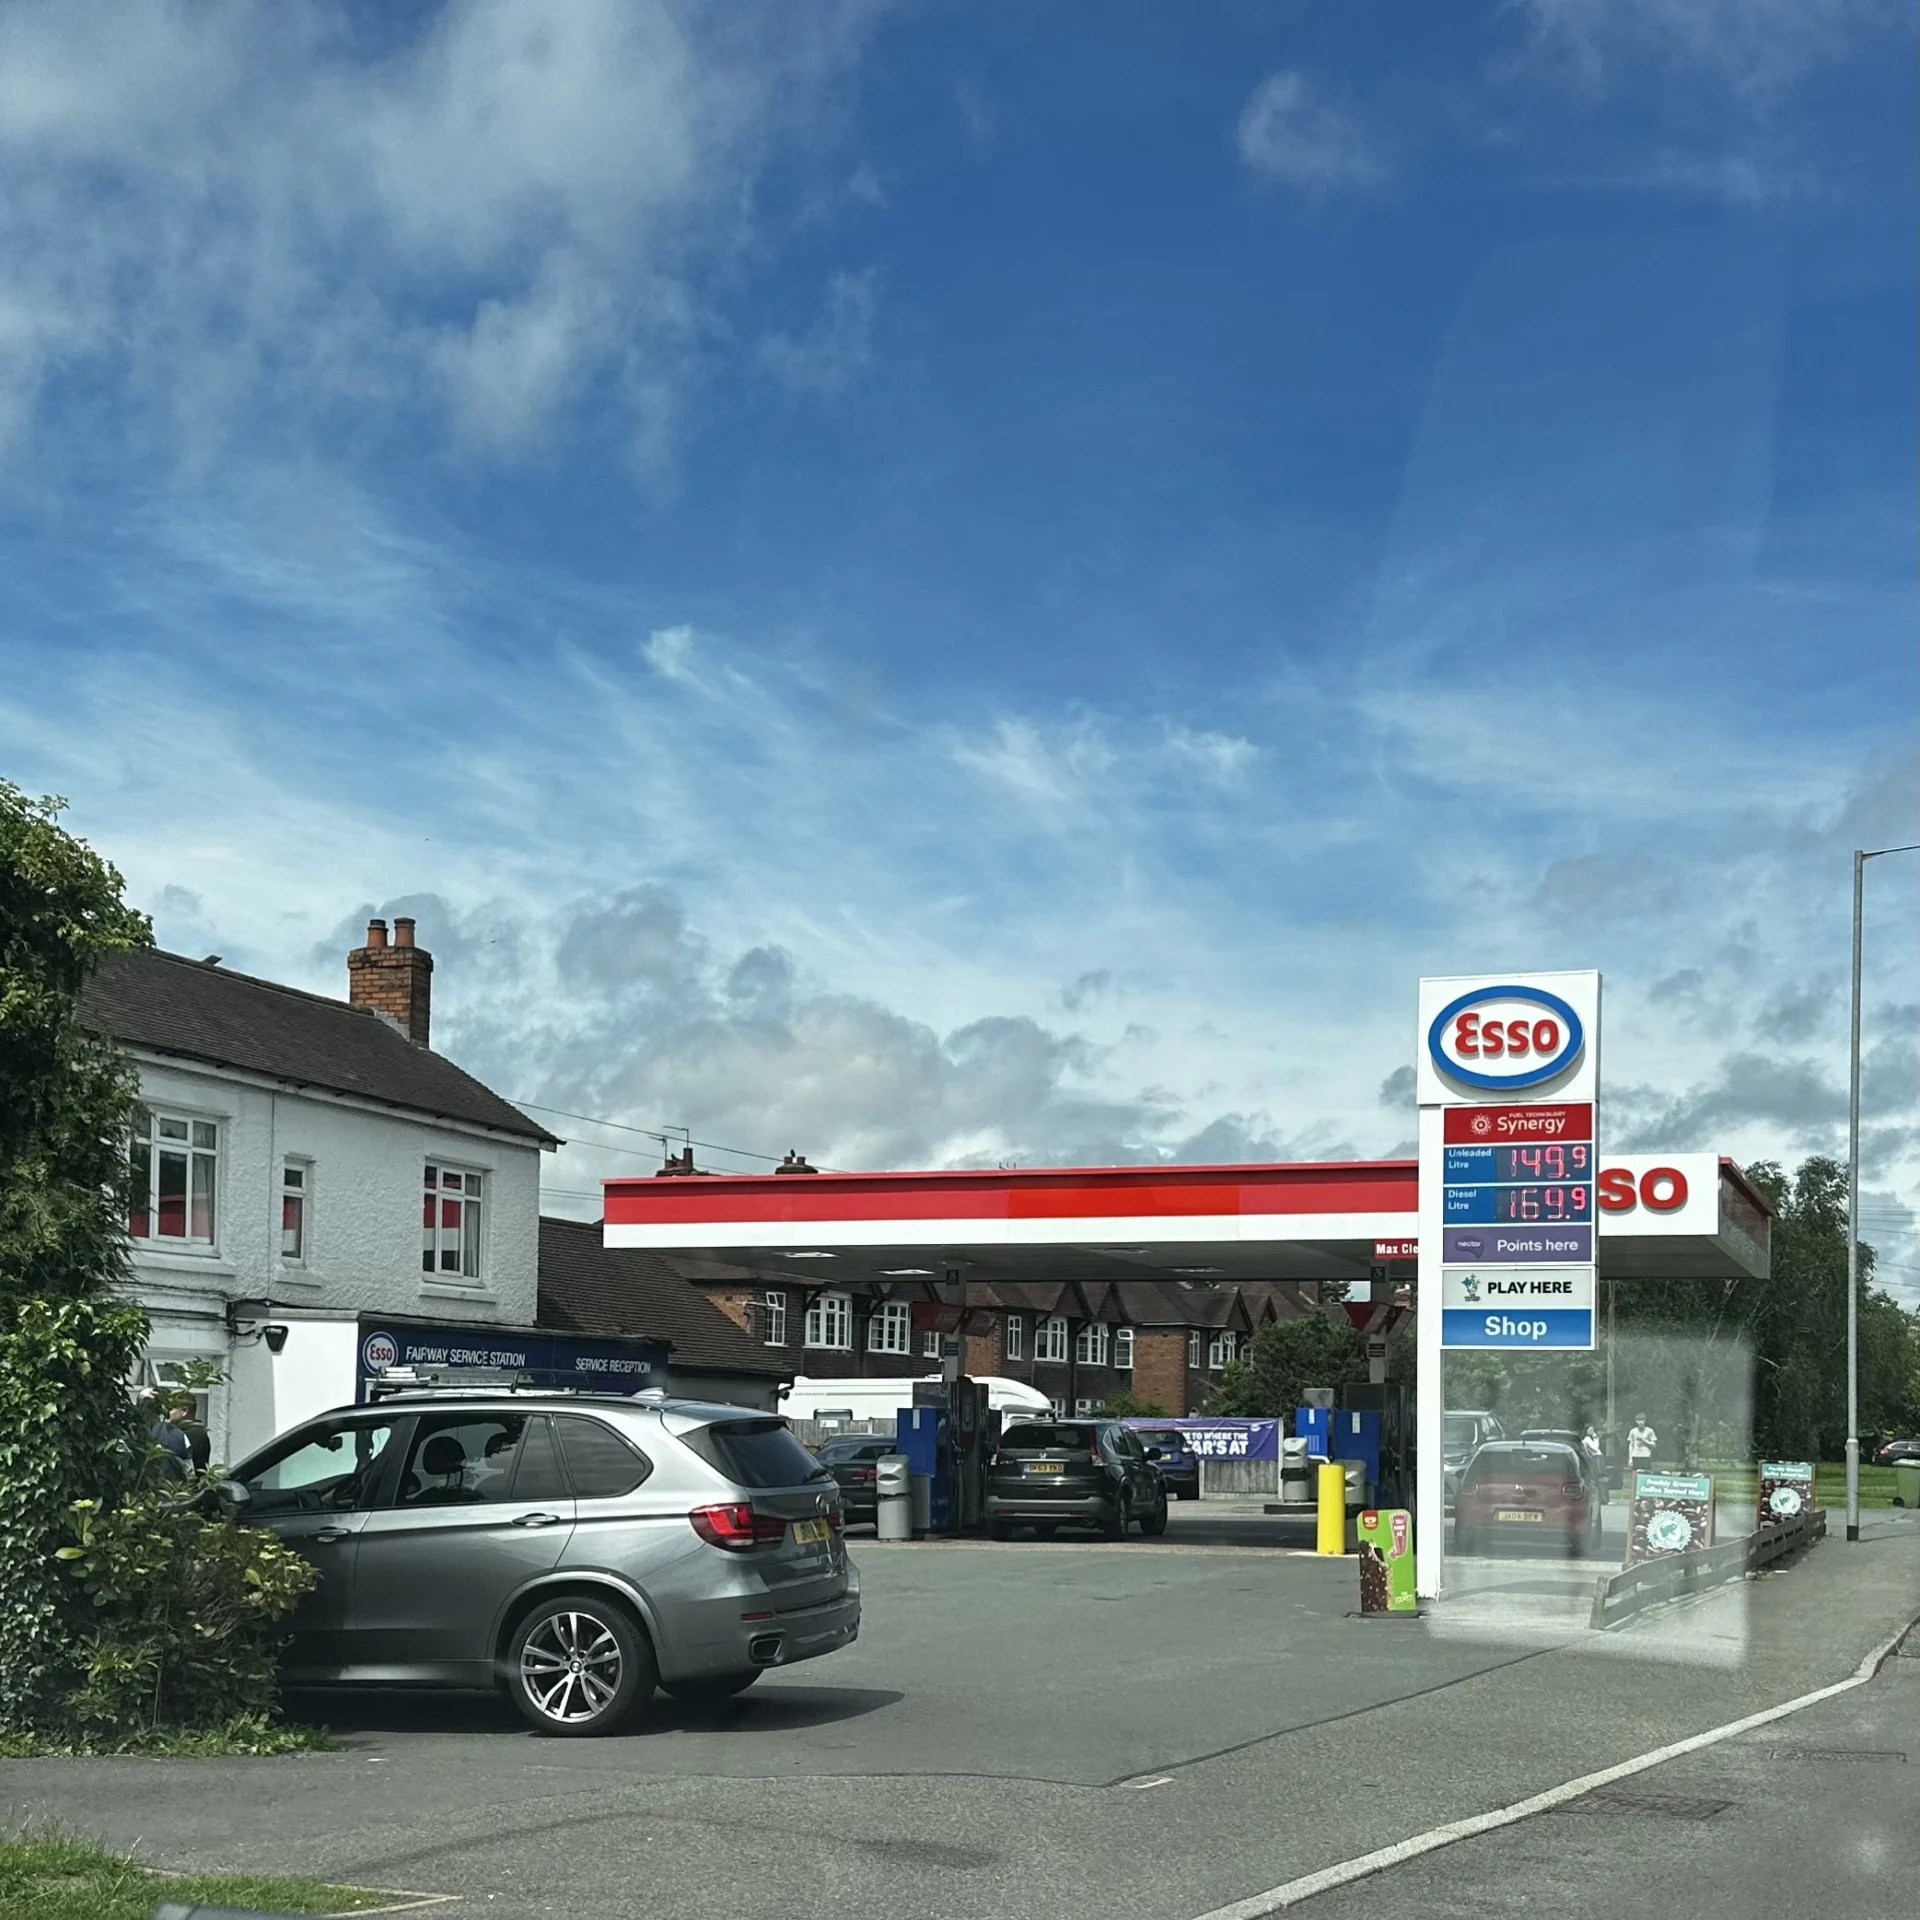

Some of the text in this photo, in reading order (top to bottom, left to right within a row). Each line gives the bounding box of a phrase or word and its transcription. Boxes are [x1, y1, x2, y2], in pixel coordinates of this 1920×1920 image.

[1497, 1116, 1566, 1135] Synergy
[1448, 1148, 1492, 1157] Unleaded
[1448, 1160, 1469, 1169] Litre
[1511, 1145, 1587, 1178] 149.9
[1448, 1189, 1477, 1198] Diesel
[1598, 1167, 1688, 1210] SO
[1448, 1201, 1469, 1210] Litre
[1510, 1186, 1587, 1220] 169.9
[1376, 1243, 1398, 1254] Max
[1497, 1239, 1579, 1252] Points here
[1487, 1281, 1573, 1294] PLAY HERE
[1484, 1315, 1547, 1340] Shop
[450, 1348, 489, 1364] SERVICE
[489, 1351, 526, 1367] STATION
[575, 1357, 652, 1374] SERVICE RECEPTION
[1192, 1432, 1203, 1441] TO
[1204, 1431, 1232, 1441] WHERE
[1233, 1432, 1249, 1440] THE
[1229, 1440, 1249, 1455] AT
